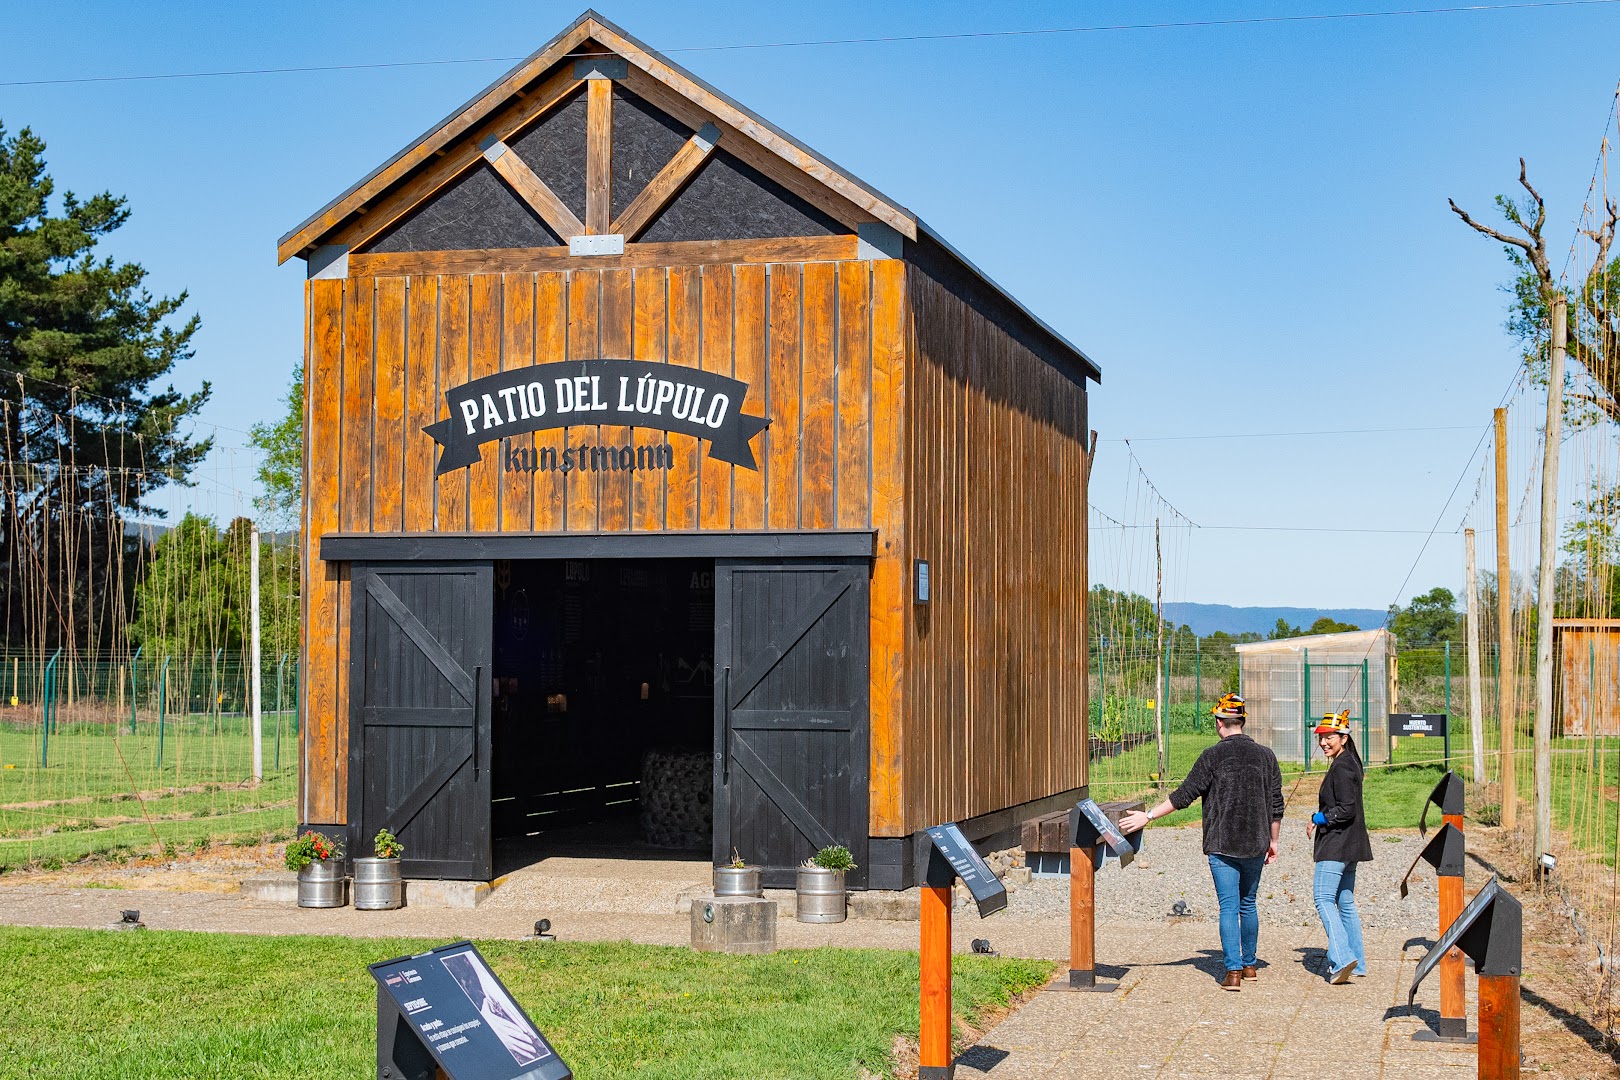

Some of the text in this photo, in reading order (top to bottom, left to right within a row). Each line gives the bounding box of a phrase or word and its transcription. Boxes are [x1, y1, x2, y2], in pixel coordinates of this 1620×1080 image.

[460, 372, 730, 435] PATIO DEL LÚPULO
[504, 438, 675, 475] kunstmann
